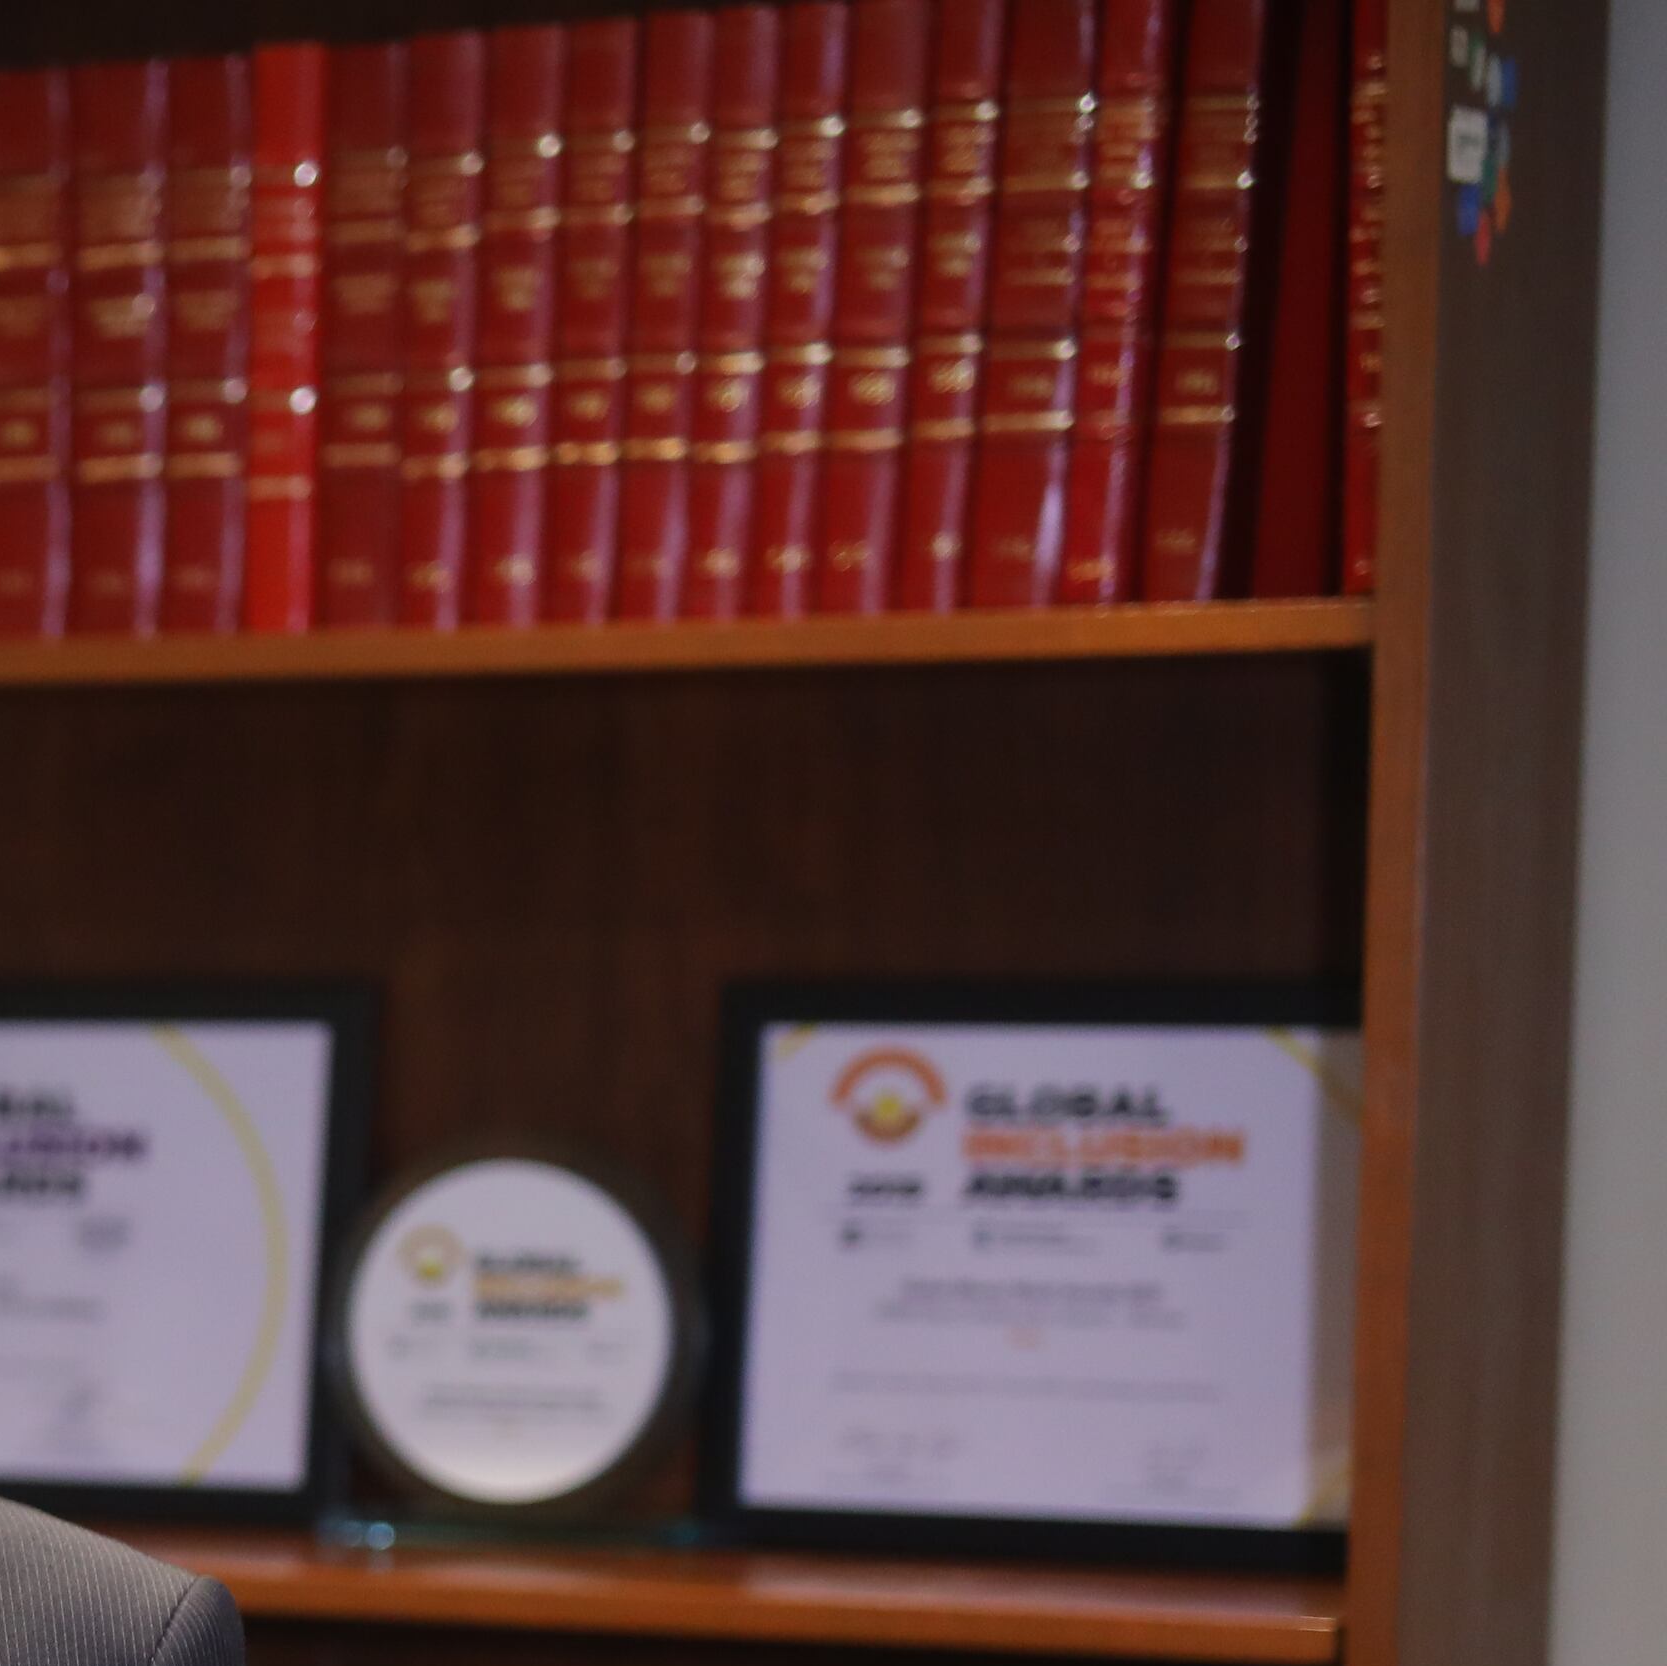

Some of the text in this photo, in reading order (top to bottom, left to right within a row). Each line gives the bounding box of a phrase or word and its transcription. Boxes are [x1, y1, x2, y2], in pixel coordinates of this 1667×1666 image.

[968, 1084, 1169, 1124] GLOBAL
[963, 1127, 1245, 1167] INCLUSION
[965, 1171, 1181, 1205] AWARDS
